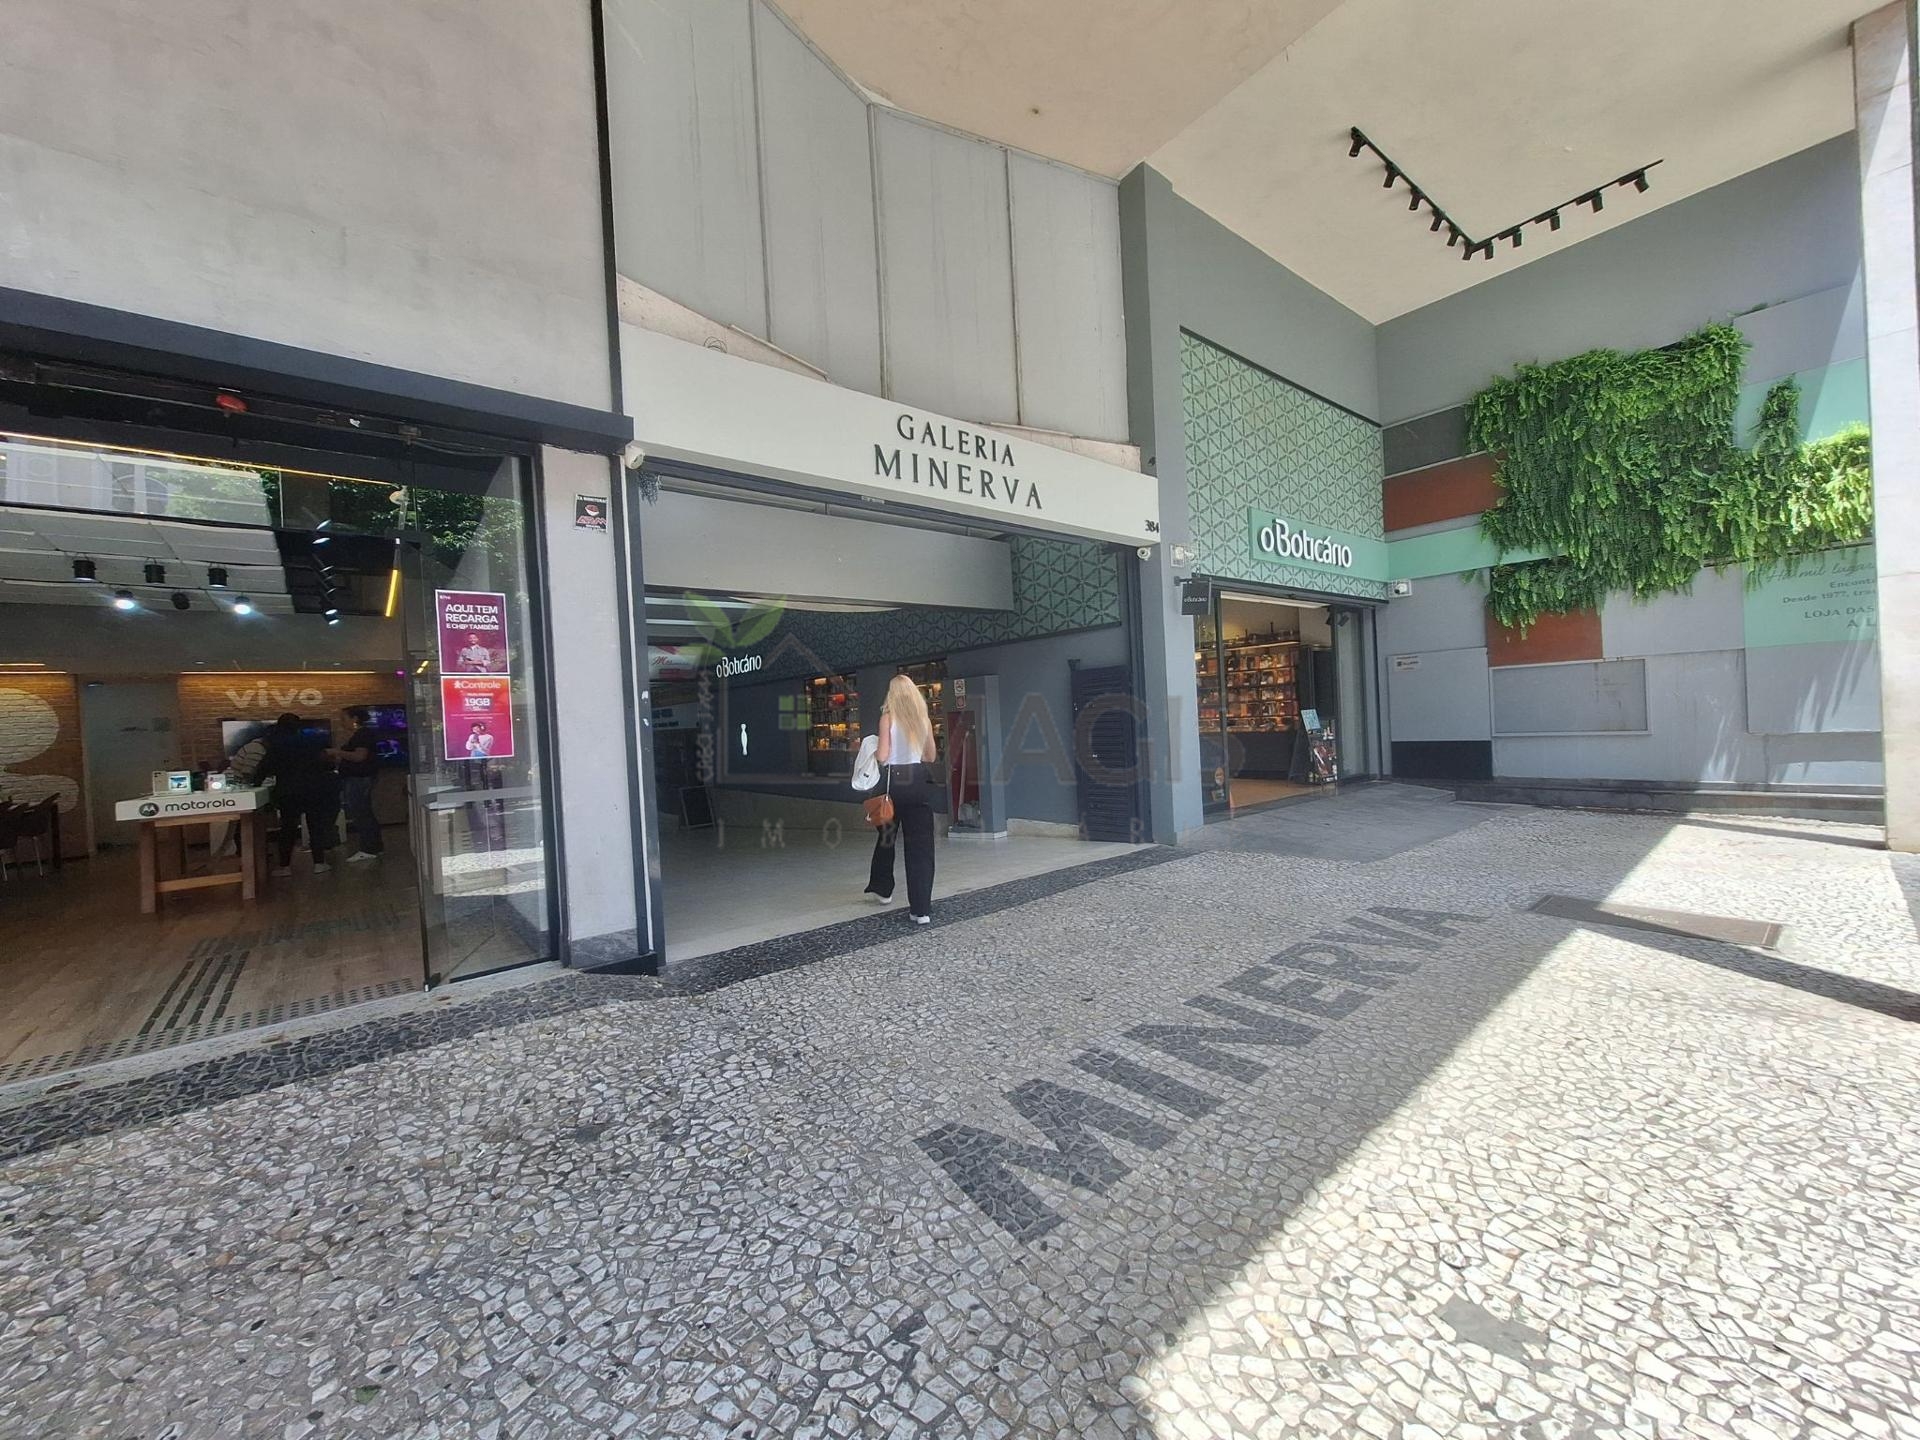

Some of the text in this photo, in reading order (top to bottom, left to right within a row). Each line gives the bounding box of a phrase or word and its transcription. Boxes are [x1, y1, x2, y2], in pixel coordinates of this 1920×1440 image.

[897, 414, 1015, 467] GALERIA
[873, 444, 1042, 509] MINERVA
[1783, 594, 1817, 603] Desde
[445, 604, 498, 614] AQUI TEM
[1804, 605, 1875, 619] LOJA DAS
[445, 613, 499, 623] RECARGA
[461, 680, 501, 689] Controle
[225, 680, 323, 708] vivo
[465, 697, 490, 706] 19GB
[165, 798, 236, 812] motorola
[912, 906, 1491, 1244] MINERVA
